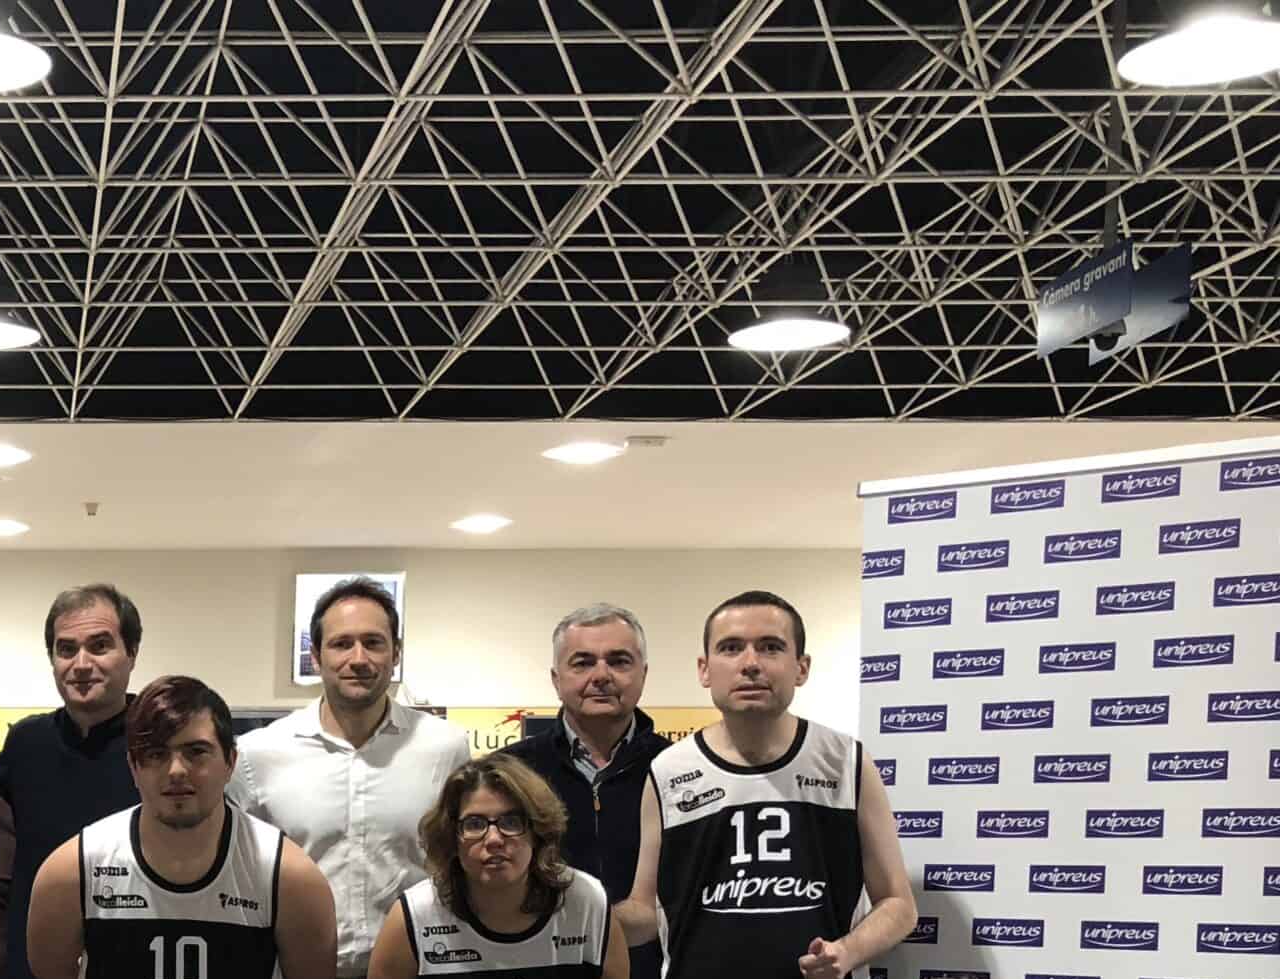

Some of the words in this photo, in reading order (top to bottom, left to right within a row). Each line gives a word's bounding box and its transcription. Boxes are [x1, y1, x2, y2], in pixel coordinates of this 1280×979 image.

[1083, 251, 1128, 291] gravant
[1105, 474, 1177, 493] unipreus
[994, 486, 1061, 504] unipreus
[891, 498, 953, 515] unipreus
[1163, 525, 1237, 544] unipreus
[1047, 536, 1117, 554] unipreus
[940, 546, 1005, 563] unipreus
[989, 596, 1055, 613] unipreus
[1099, 587, 1171, 605] unipreus
[887, 603, 948, 620] unipreus
[1042, 647, 1112, 665] unipreus
[1156, 640, 1230, 659] unipreus
[936, 653, 1000, 670] unipreus
[883, 708, 943, 726] unipreus
[984, 704, 1050, 722] unipreus
[1094, 700, 1165, 718] unipreus
[931, 760, 996, 777] unipreus
[1037, 757, 1107, 775] unipreus
[1151, 754, 1224, 773] unipreus
[979, 813, 1045, 830] unipreus
[1089, 812, 1160, 830] unipreus
[730, 807, 792, 865] 12
[927, 866, 991, 883] unipreus
[1032, 867, 1102, 885] unipreus
[1145, 868, 1219, 887] unipreus
[701, 868, 826, 907] unipreus
[975, 920, 1040, 938] unipreus
[1084, 923, 1155, 941] unipreus
[1199, 926, 1276, 945] unipreus
